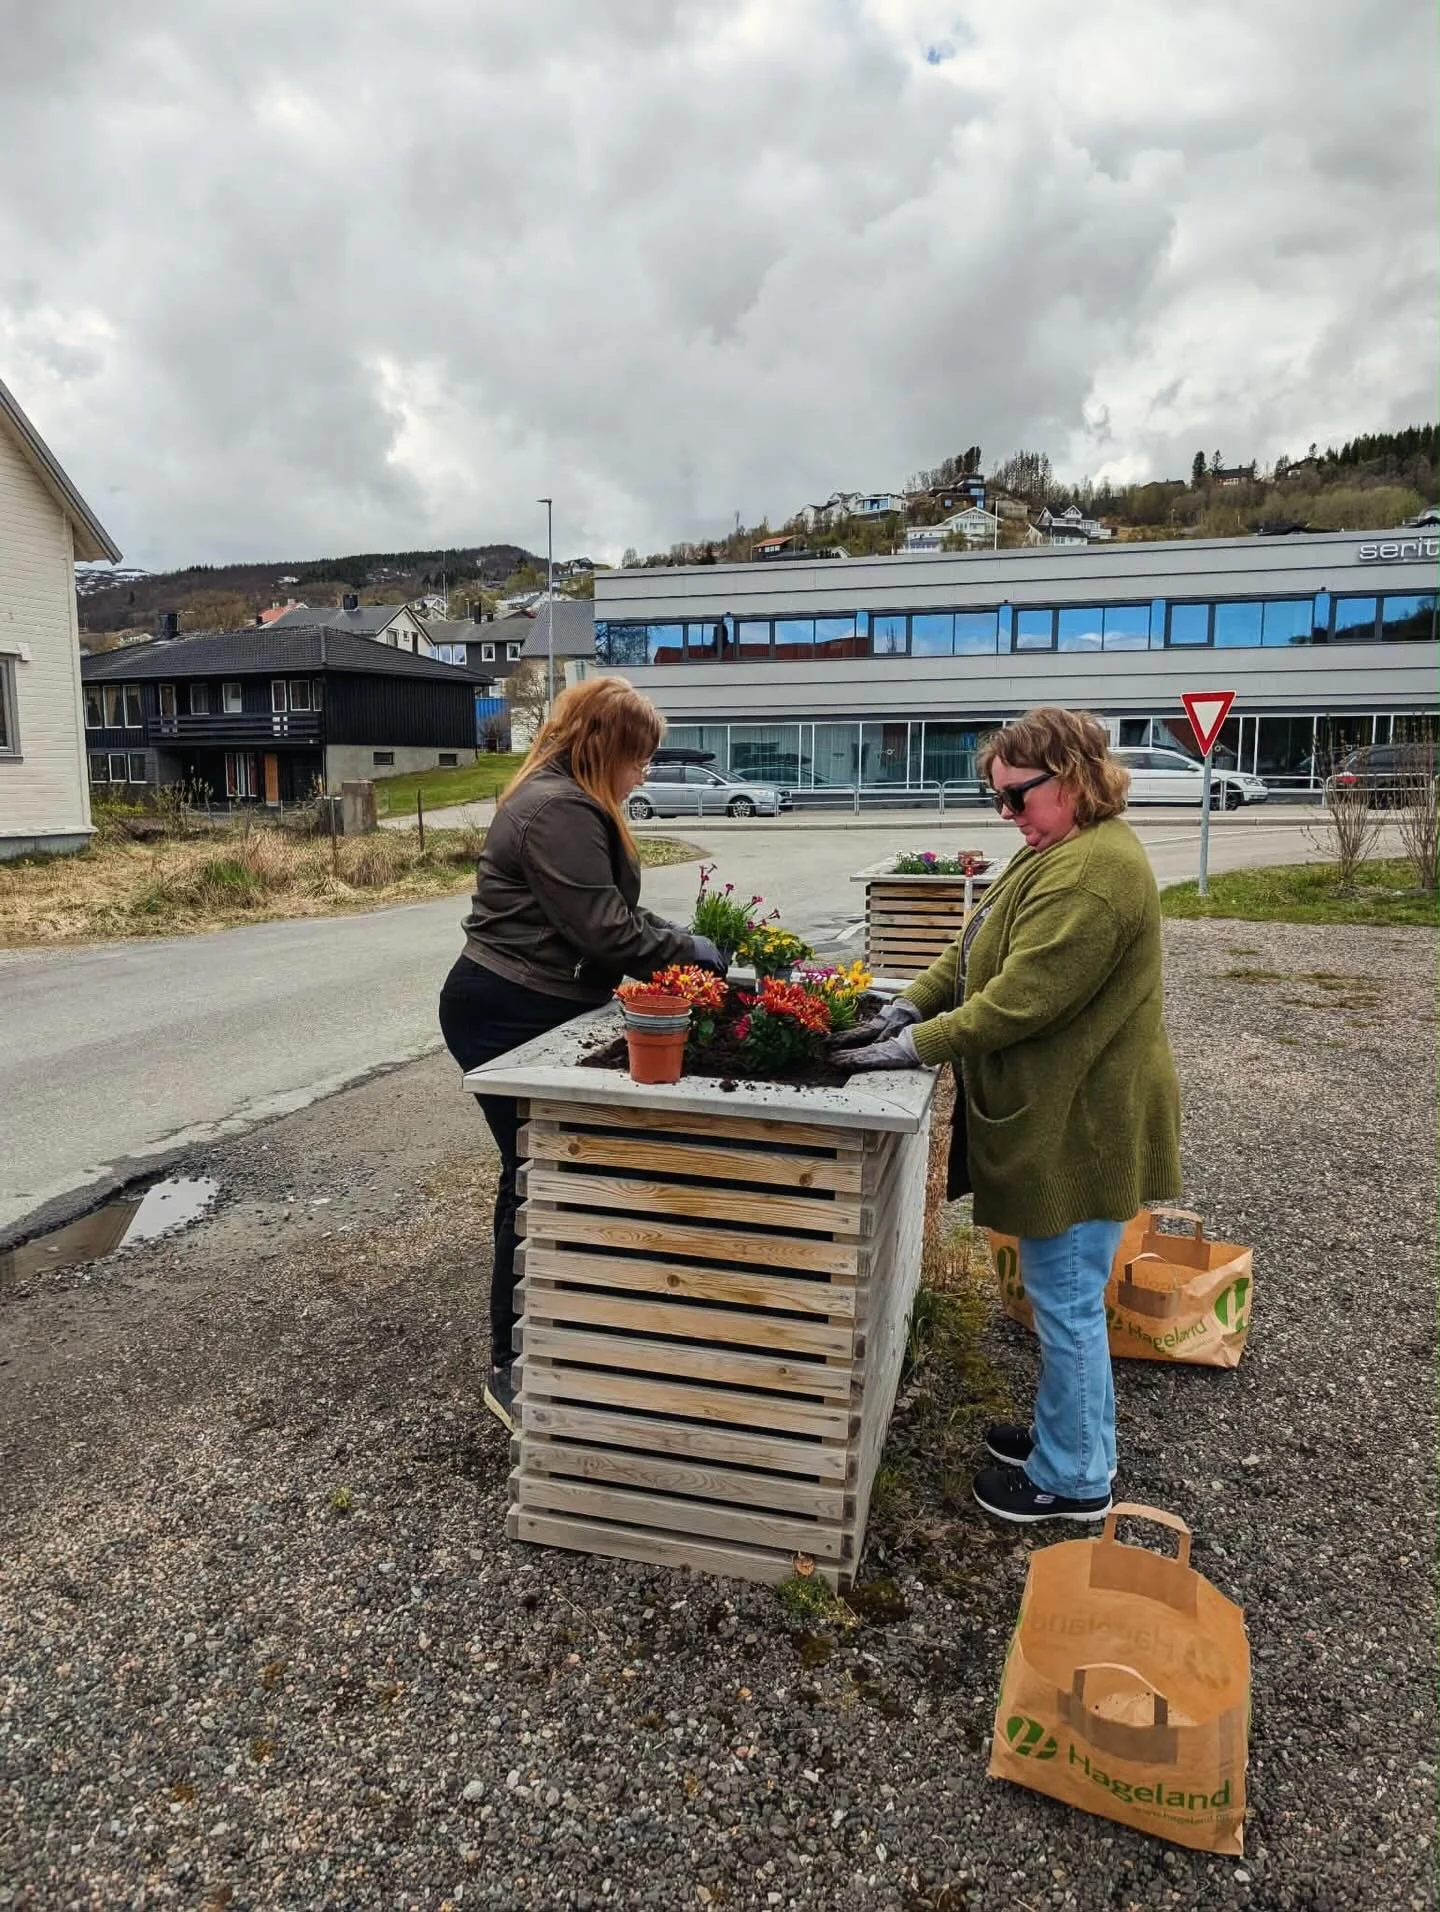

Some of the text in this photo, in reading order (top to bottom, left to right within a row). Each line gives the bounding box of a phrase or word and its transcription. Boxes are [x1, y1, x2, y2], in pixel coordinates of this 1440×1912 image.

[1360, 537, 1440, 560] serit
[1127, 1315, 1207, 1353] Hageland
[1068, 1743, 1231, 1810] Hageland
